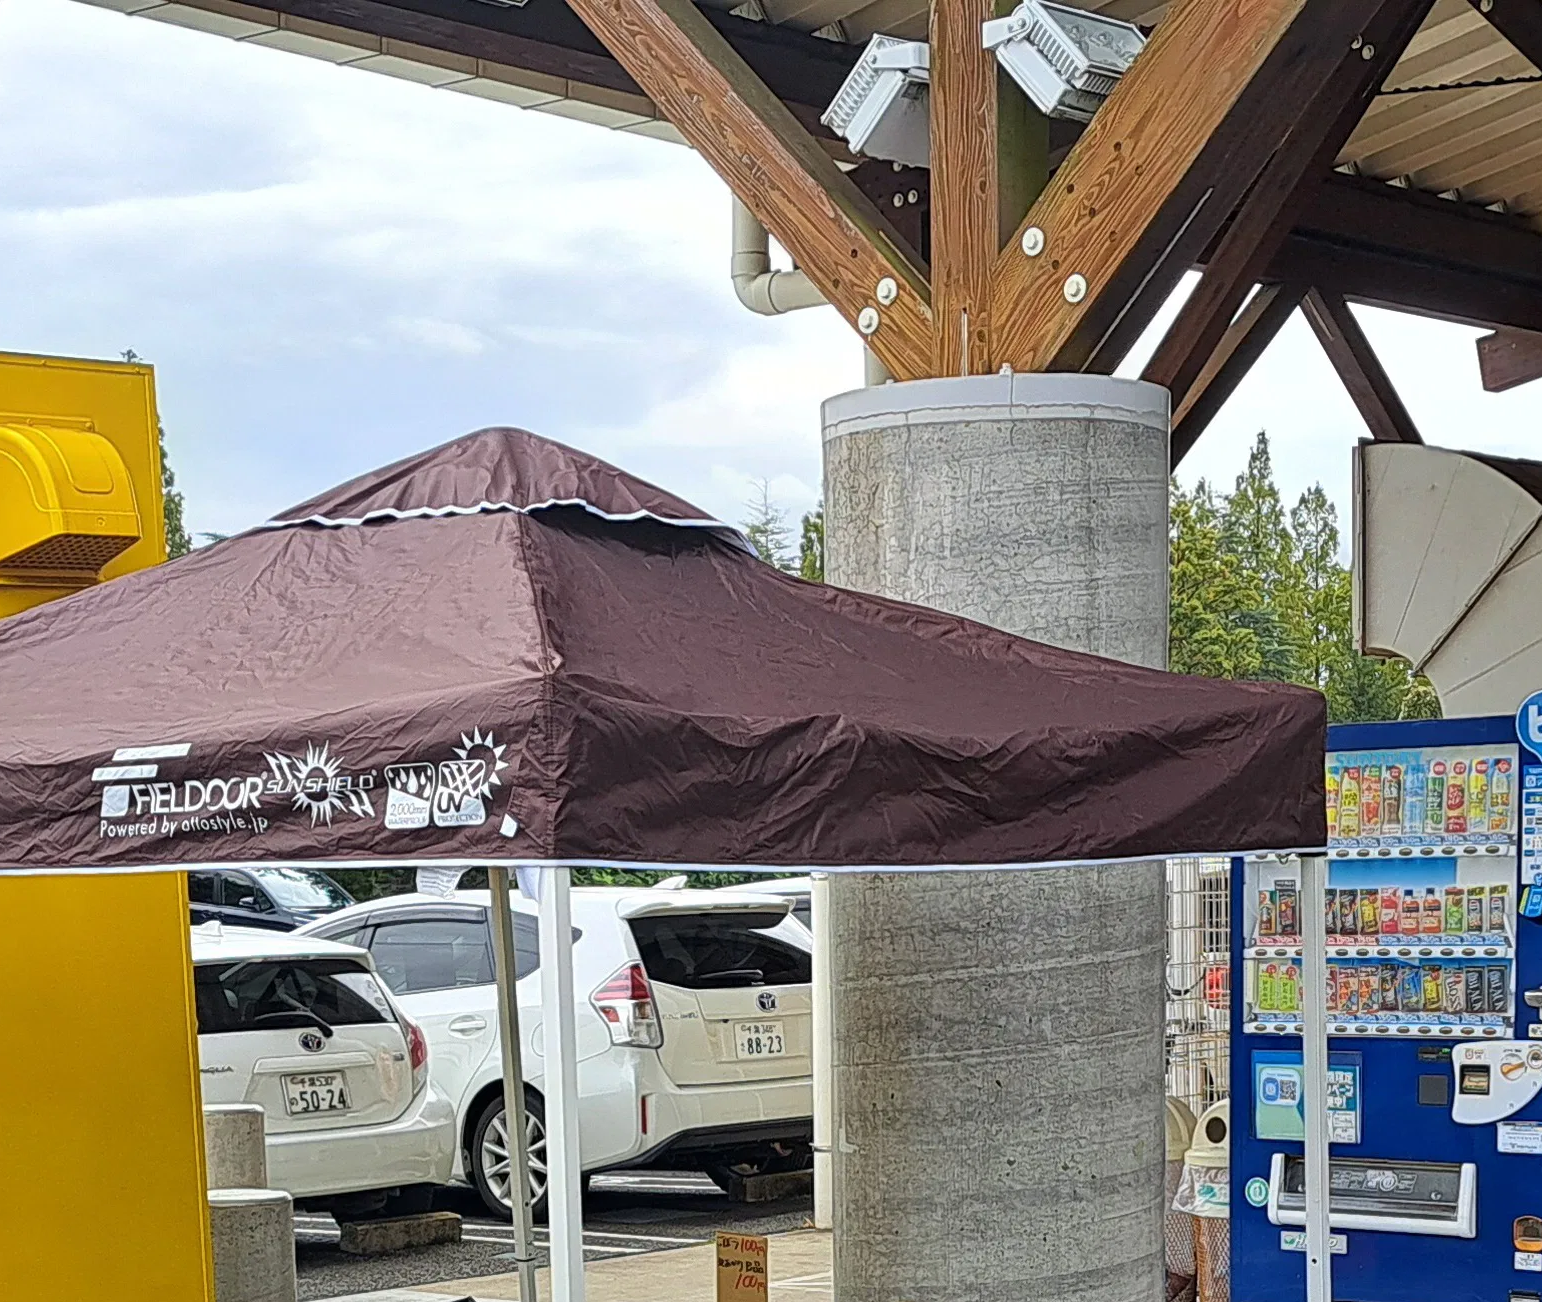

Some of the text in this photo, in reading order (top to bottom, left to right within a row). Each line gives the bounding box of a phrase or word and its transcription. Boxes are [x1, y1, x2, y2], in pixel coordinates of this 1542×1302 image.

[130, 777, 263, 815] FIELDOOR
[264, 775, 374, 794] SUNSHIELD
[100, 817, 157, 838] Powered
[161, 815, 180, 838] by
[747, 1035, 782, 1055] 88-23
[299, 1088, 347, 1112] 50-24
